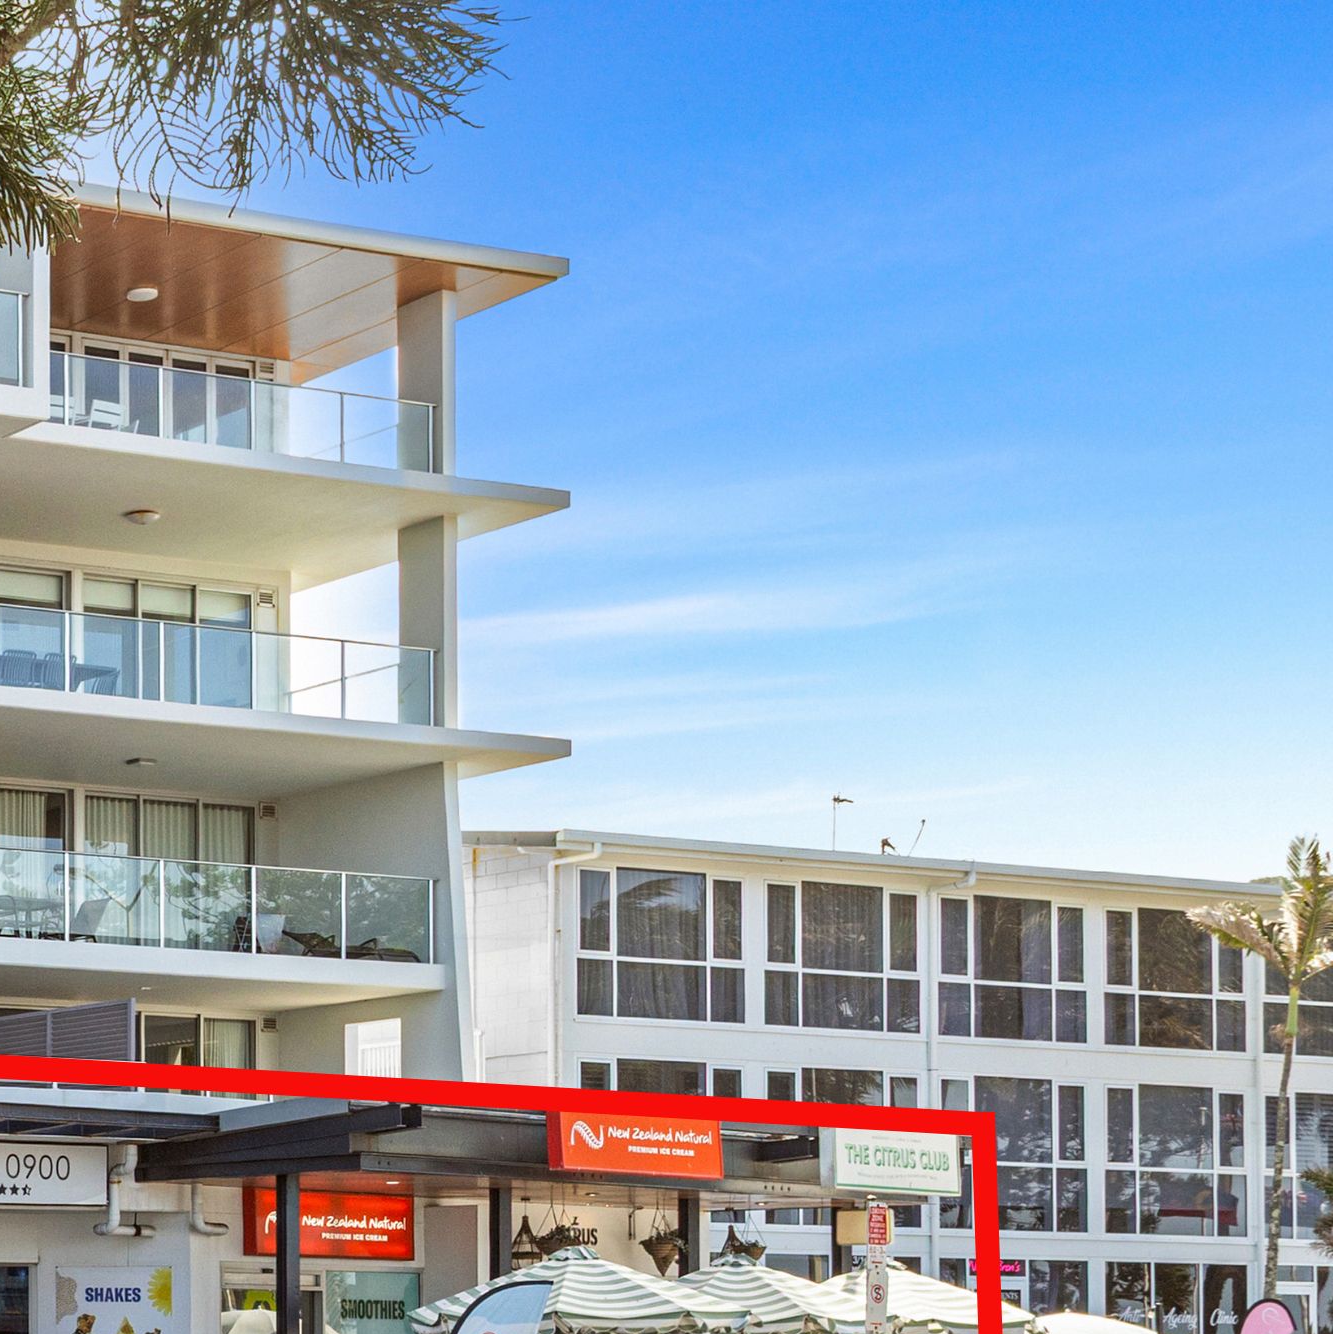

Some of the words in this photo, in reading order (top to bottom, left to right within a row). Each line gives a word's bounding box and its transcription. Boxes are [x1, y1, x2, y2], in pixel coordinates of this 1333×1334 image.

[608, 1126, 630, 1138] New
[632, 1127, 673, 1142] Zealand
[675, 1129, 712, 1144] Natural
[628, 1145, 658, 1154] PREMIUM
[659, 1147, 671, 1155] ICE
[672, 1148, 695, 1156] CREAM
[845, 1143, 870, 1165] THE
[874, 1145, 916, 1169] CITRUS
[920, 1149, 950, 1171] CLUB
[5, 1153, 71, 1181] 0900
[302, 1215, 323, 1227] New
[326, 1215, 367, 1230] Zealand
[369, 1216, 406, 1231] Natural
[321, 1232, 351, 1241] PREMIUM
[353, 1233, 364, 1241] ICE
[365, 1234, 388, 1242] CREAM
[85, 1287, 141, 1303] SHAKES
[340, 1299, 405, 1320] SMOOTHIES
[1163, 1307, 1197, 1330] Ageing
[1210, 1308, 1239, 1327] Clinic
